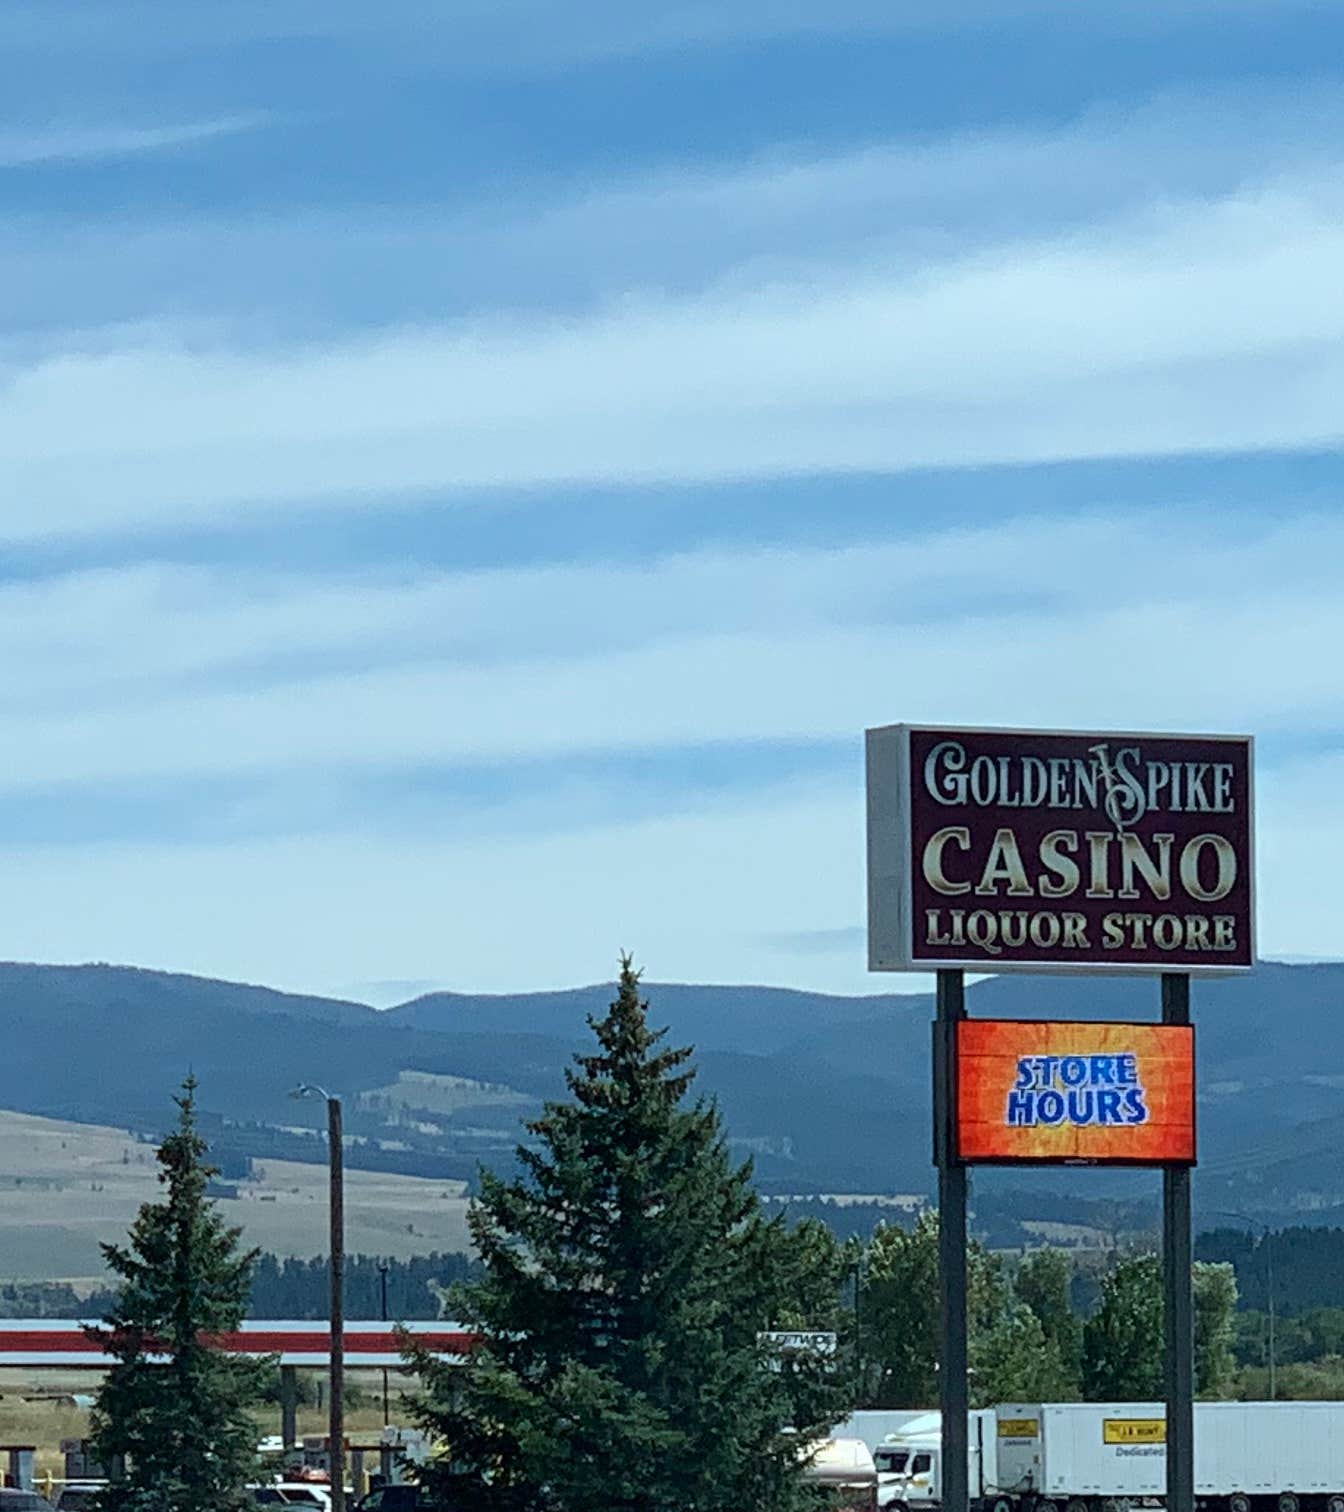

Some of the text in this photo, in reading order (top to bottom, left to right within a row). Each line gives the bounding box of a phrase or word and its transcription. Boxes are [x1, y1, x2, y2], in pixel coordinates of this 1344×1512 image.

[924, 741, 1236, 828] GOLDEN SPIKE
[921, 826, 1238, 902] CASINO
[925, 908, 1237, 954] LIQUOR STORE
[1017, 1054, 1138, 1089] STORE
[1007, 1088, 1147, 1124] HOURS
